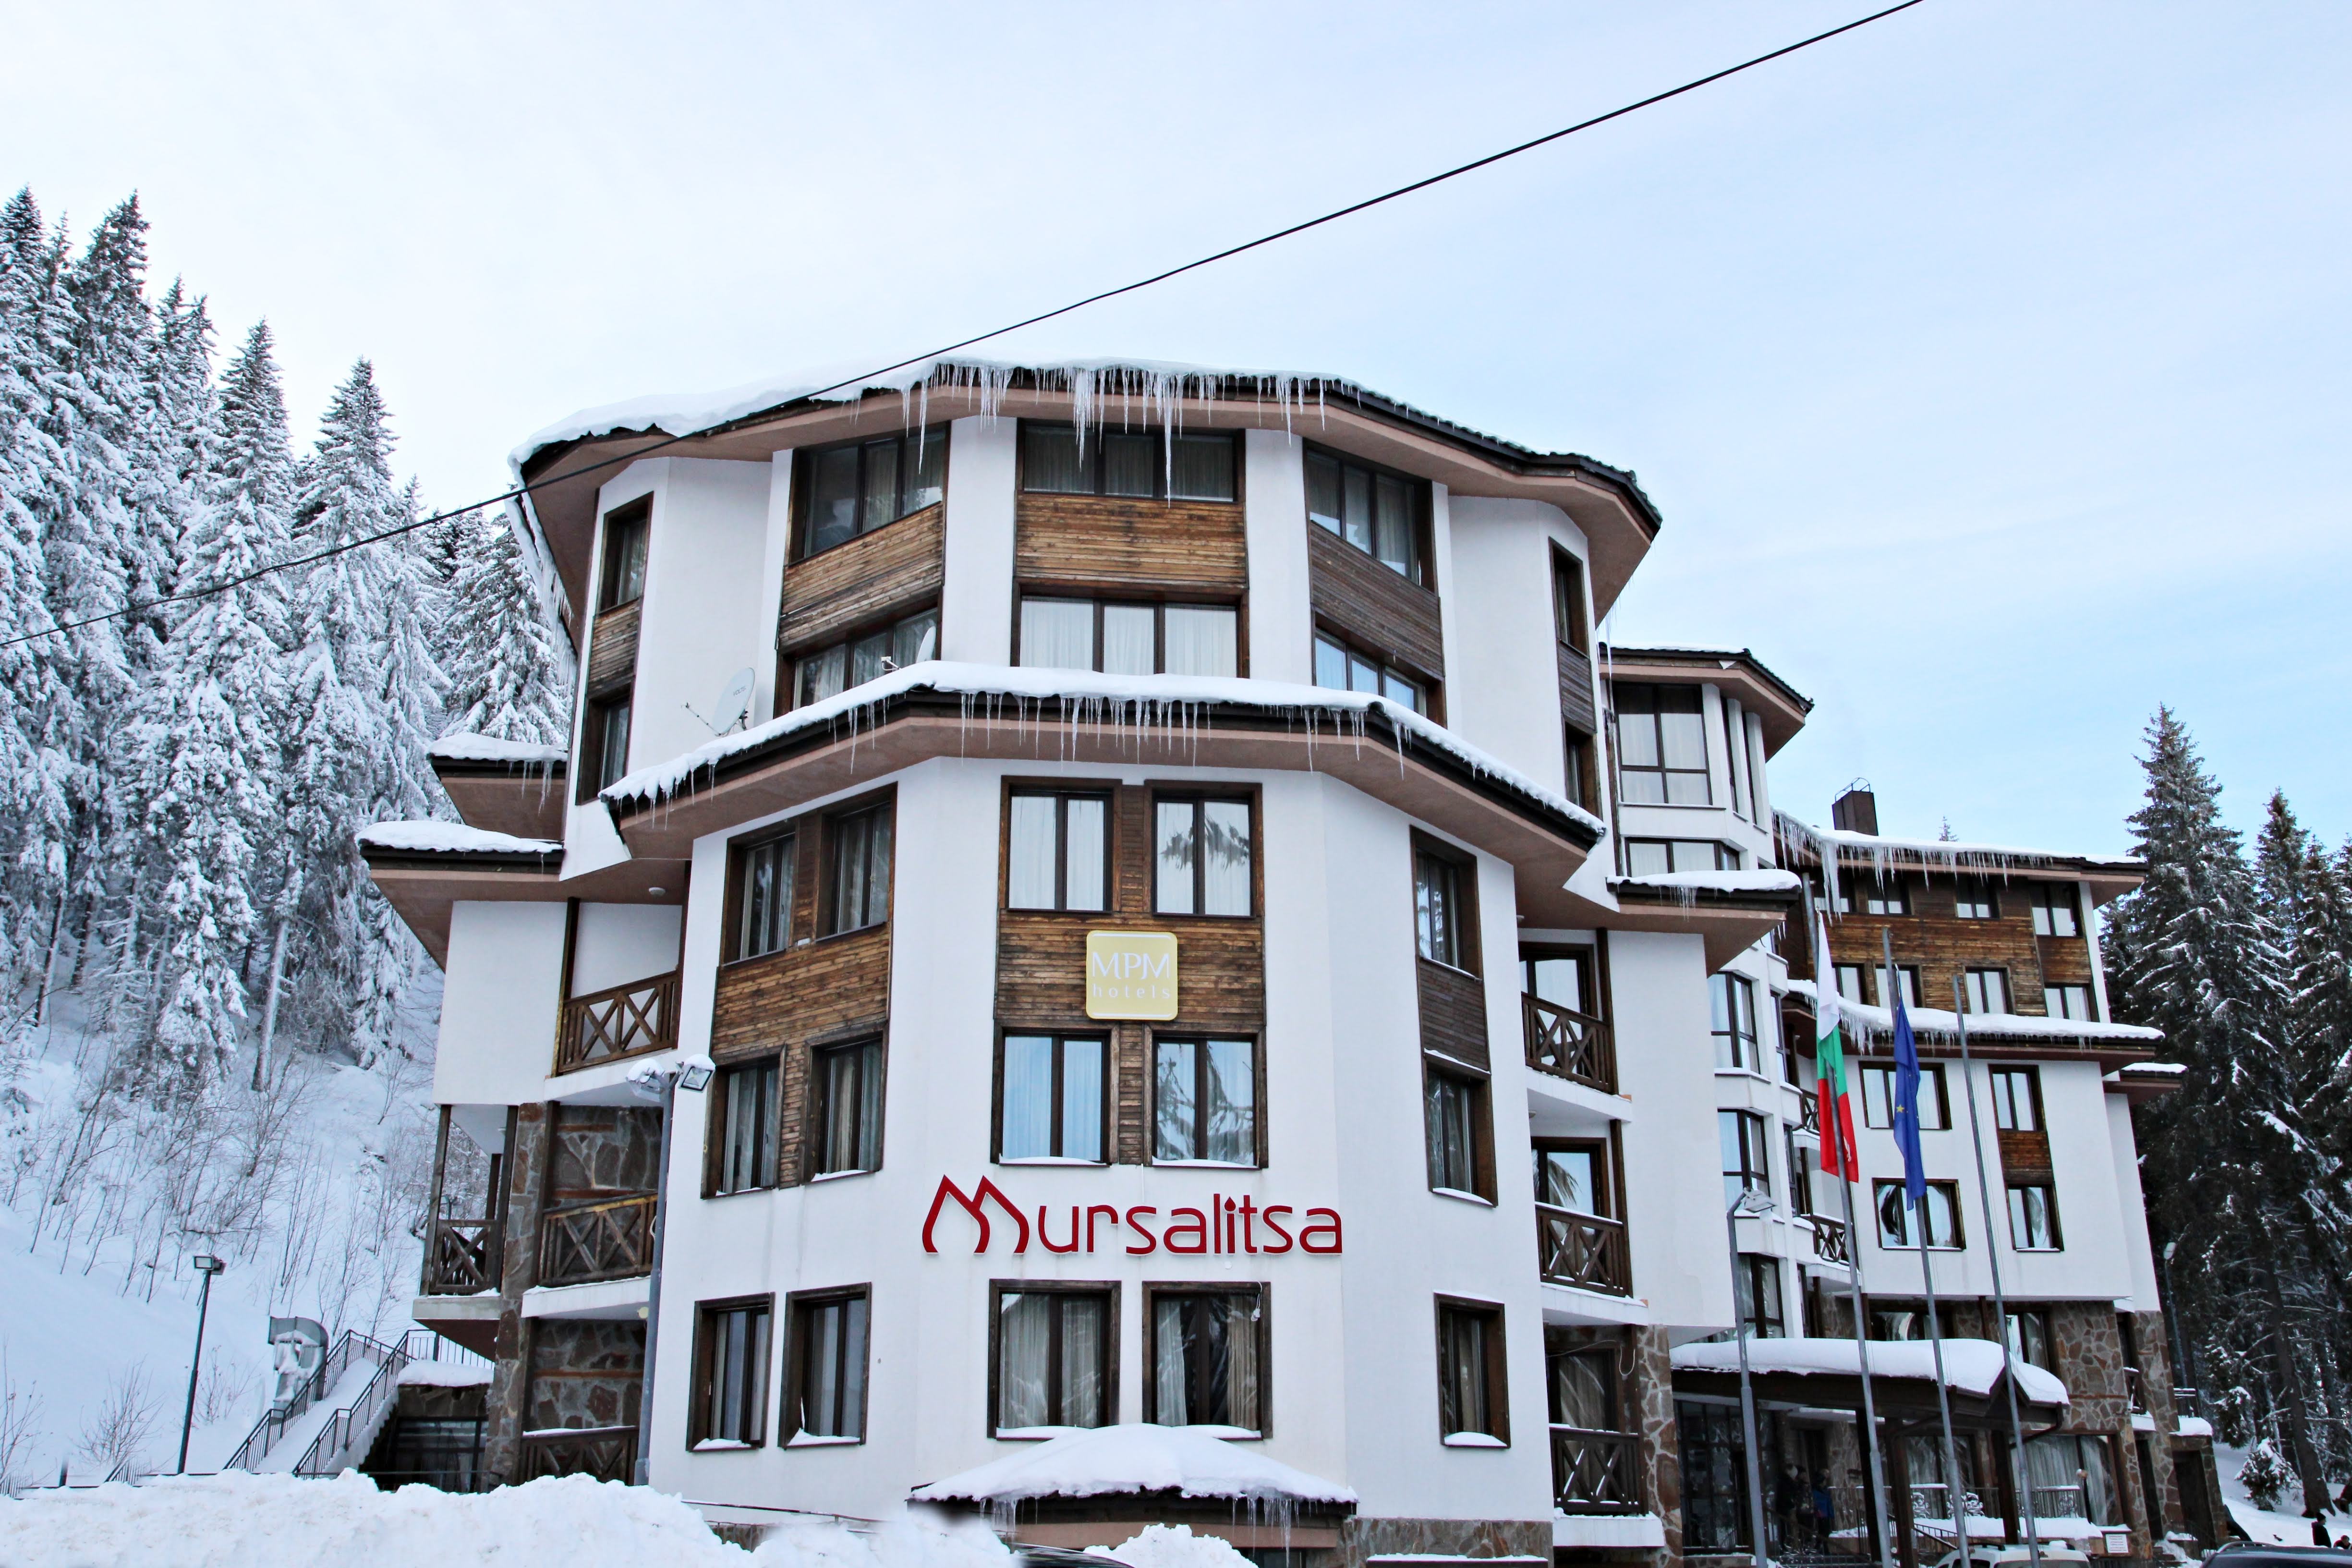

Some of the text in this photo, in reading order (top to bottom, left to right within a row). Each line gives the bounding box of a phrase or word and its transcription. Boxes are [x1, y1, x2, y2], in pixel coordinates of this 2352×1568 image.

[1091, 951, 1171, 979] MPM
[1092, 983, 1171, 999] hotels
[921, 1175, 1343, 1255] Mursalitsa
